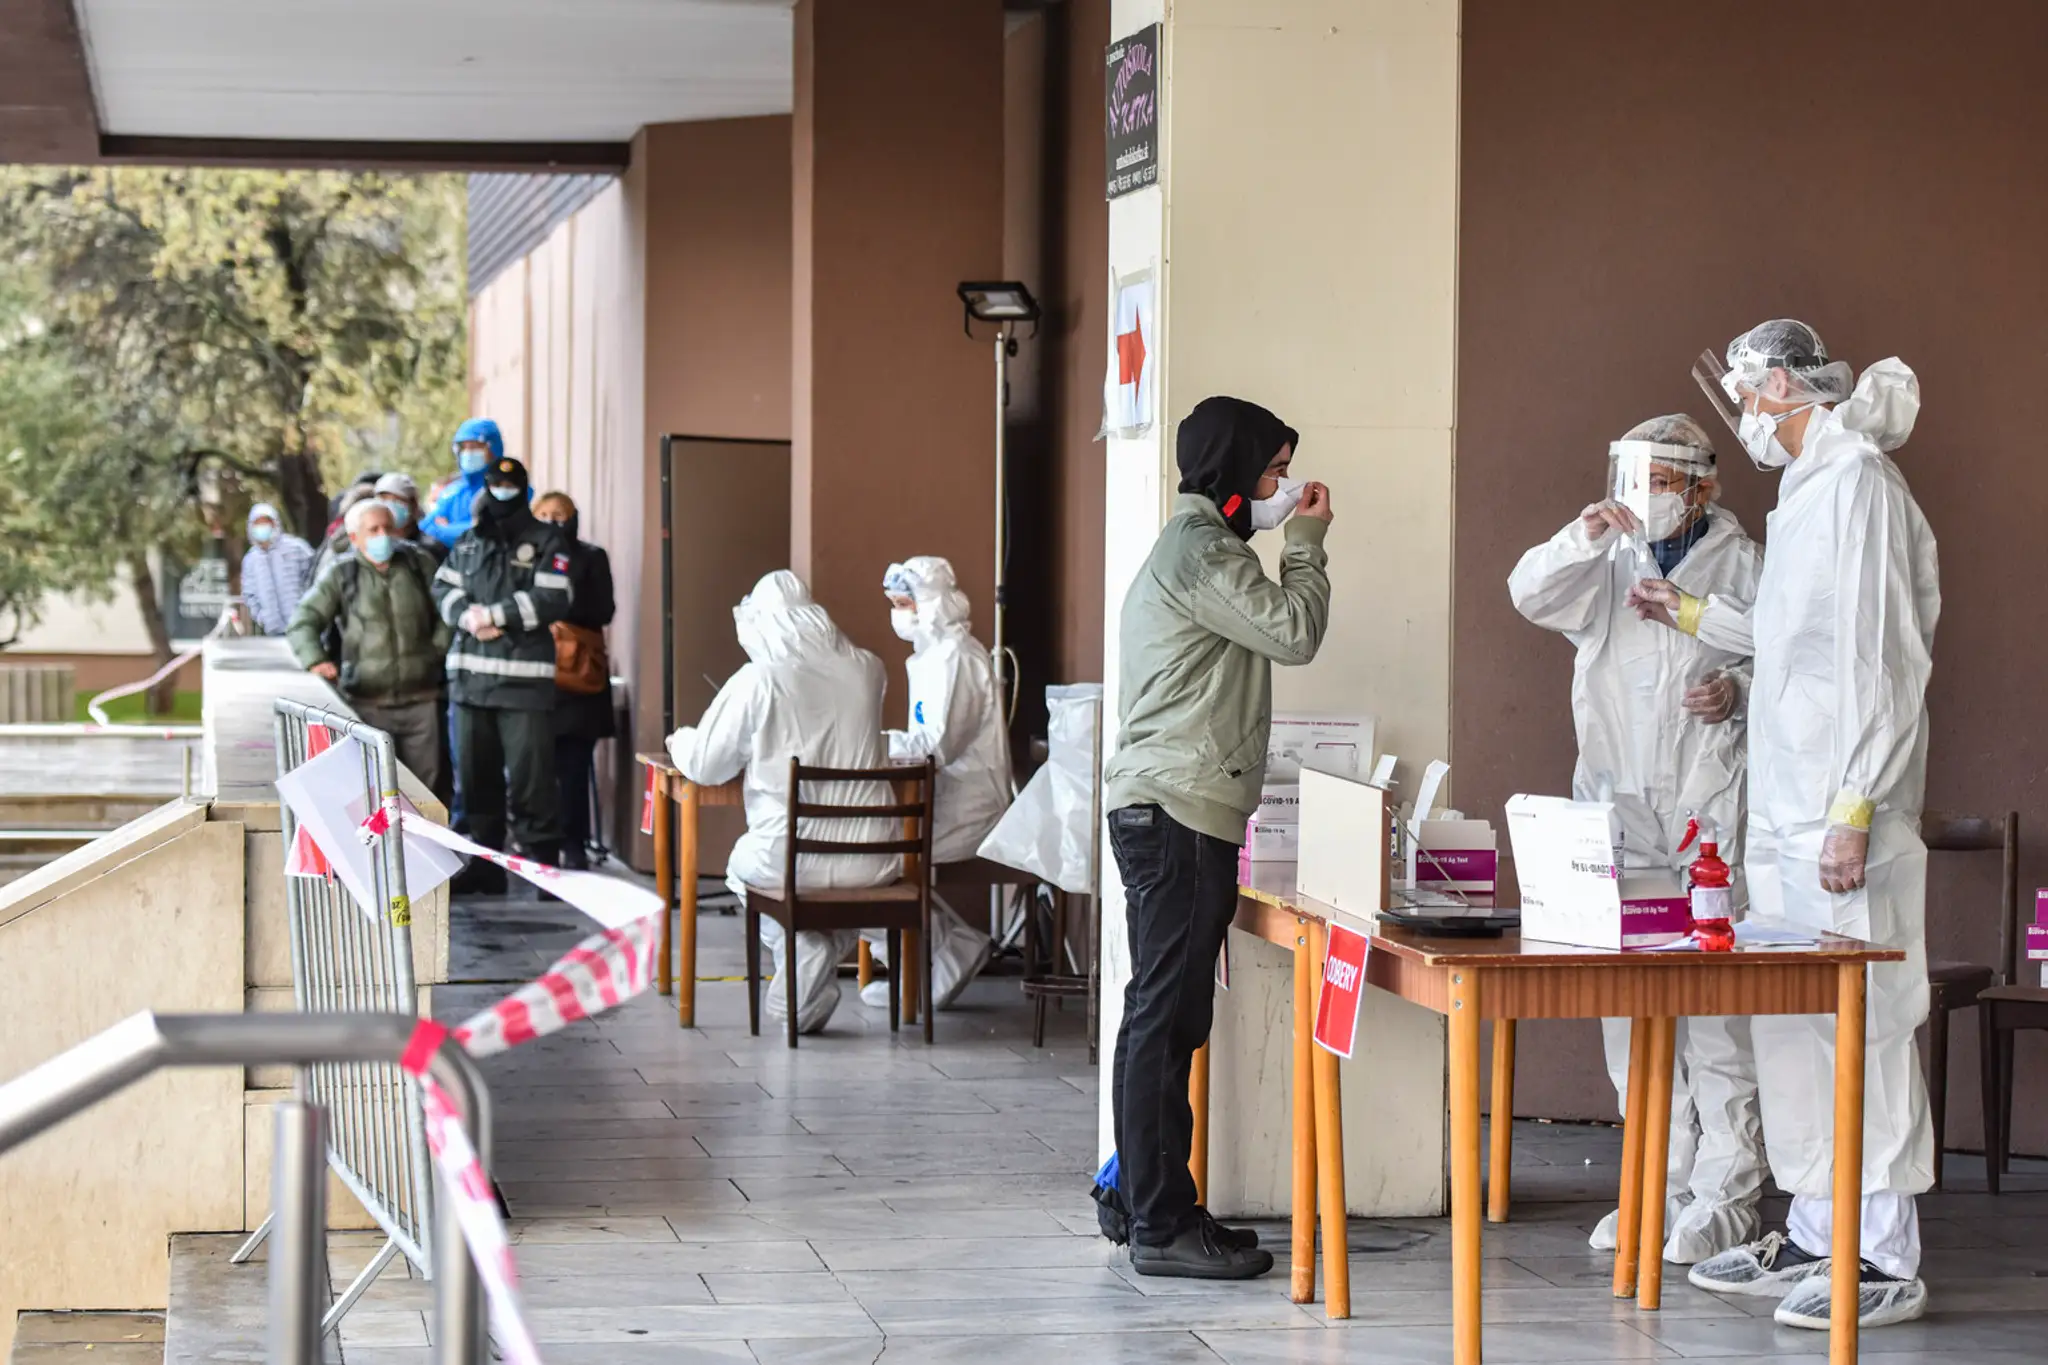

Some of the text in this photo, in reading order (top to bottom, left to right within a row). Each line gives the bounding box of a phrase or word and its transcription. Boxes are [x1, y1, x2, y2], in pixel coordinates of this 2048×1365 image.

[1263, 797, 1294, 805] COVID-19
[1580, 862, 1610, 874] COVID-19
[1326, 954, 1359, 993] ODBERY
